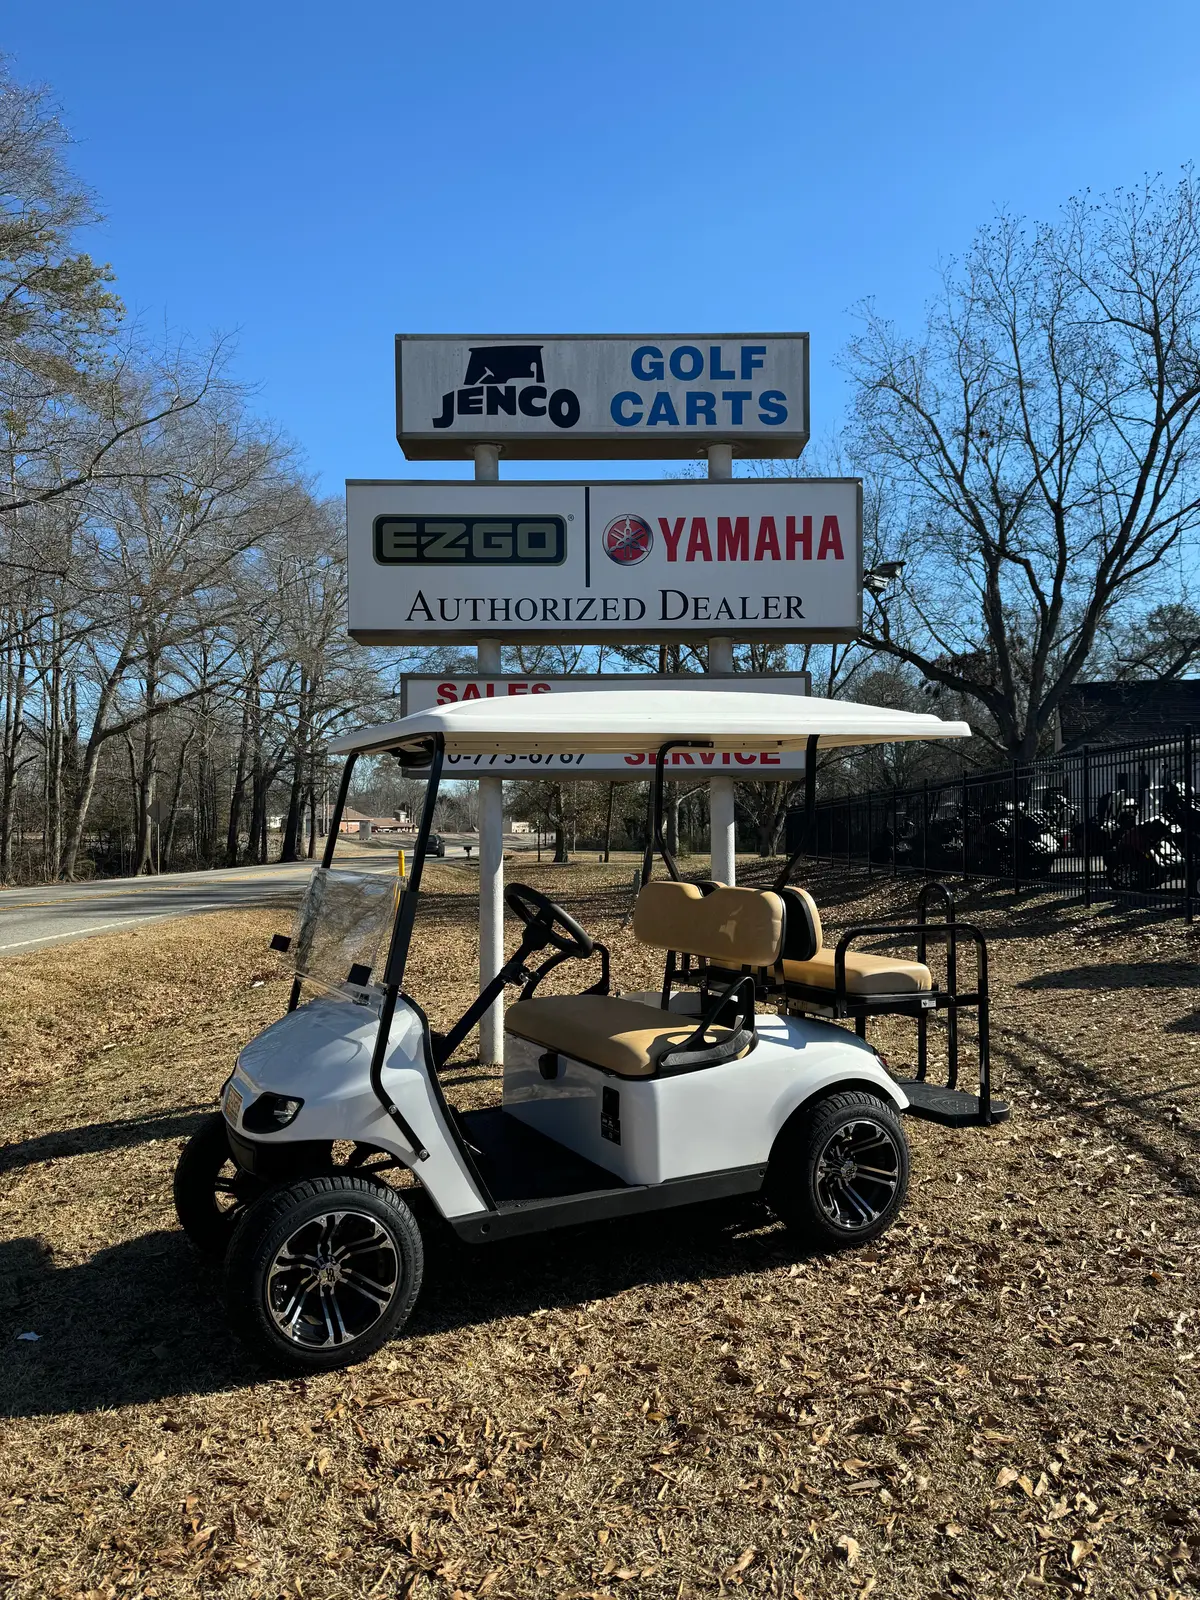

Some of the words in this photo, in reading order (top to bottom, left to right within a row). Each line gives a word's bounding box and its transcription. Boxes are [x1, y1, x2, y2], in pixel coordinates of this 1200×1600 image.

[630, 345, 767, 382] GOLF
[432, 385, 581, 429] JENCO
[610, 389, 788, 427] CARTS
[382, 522, 557, 558] EZGO
[658, 515, 844, 562] YAMAHA
[404, 589, 646, 622] AUTHORIZED
[658, 589, 806, 621] DEALER
